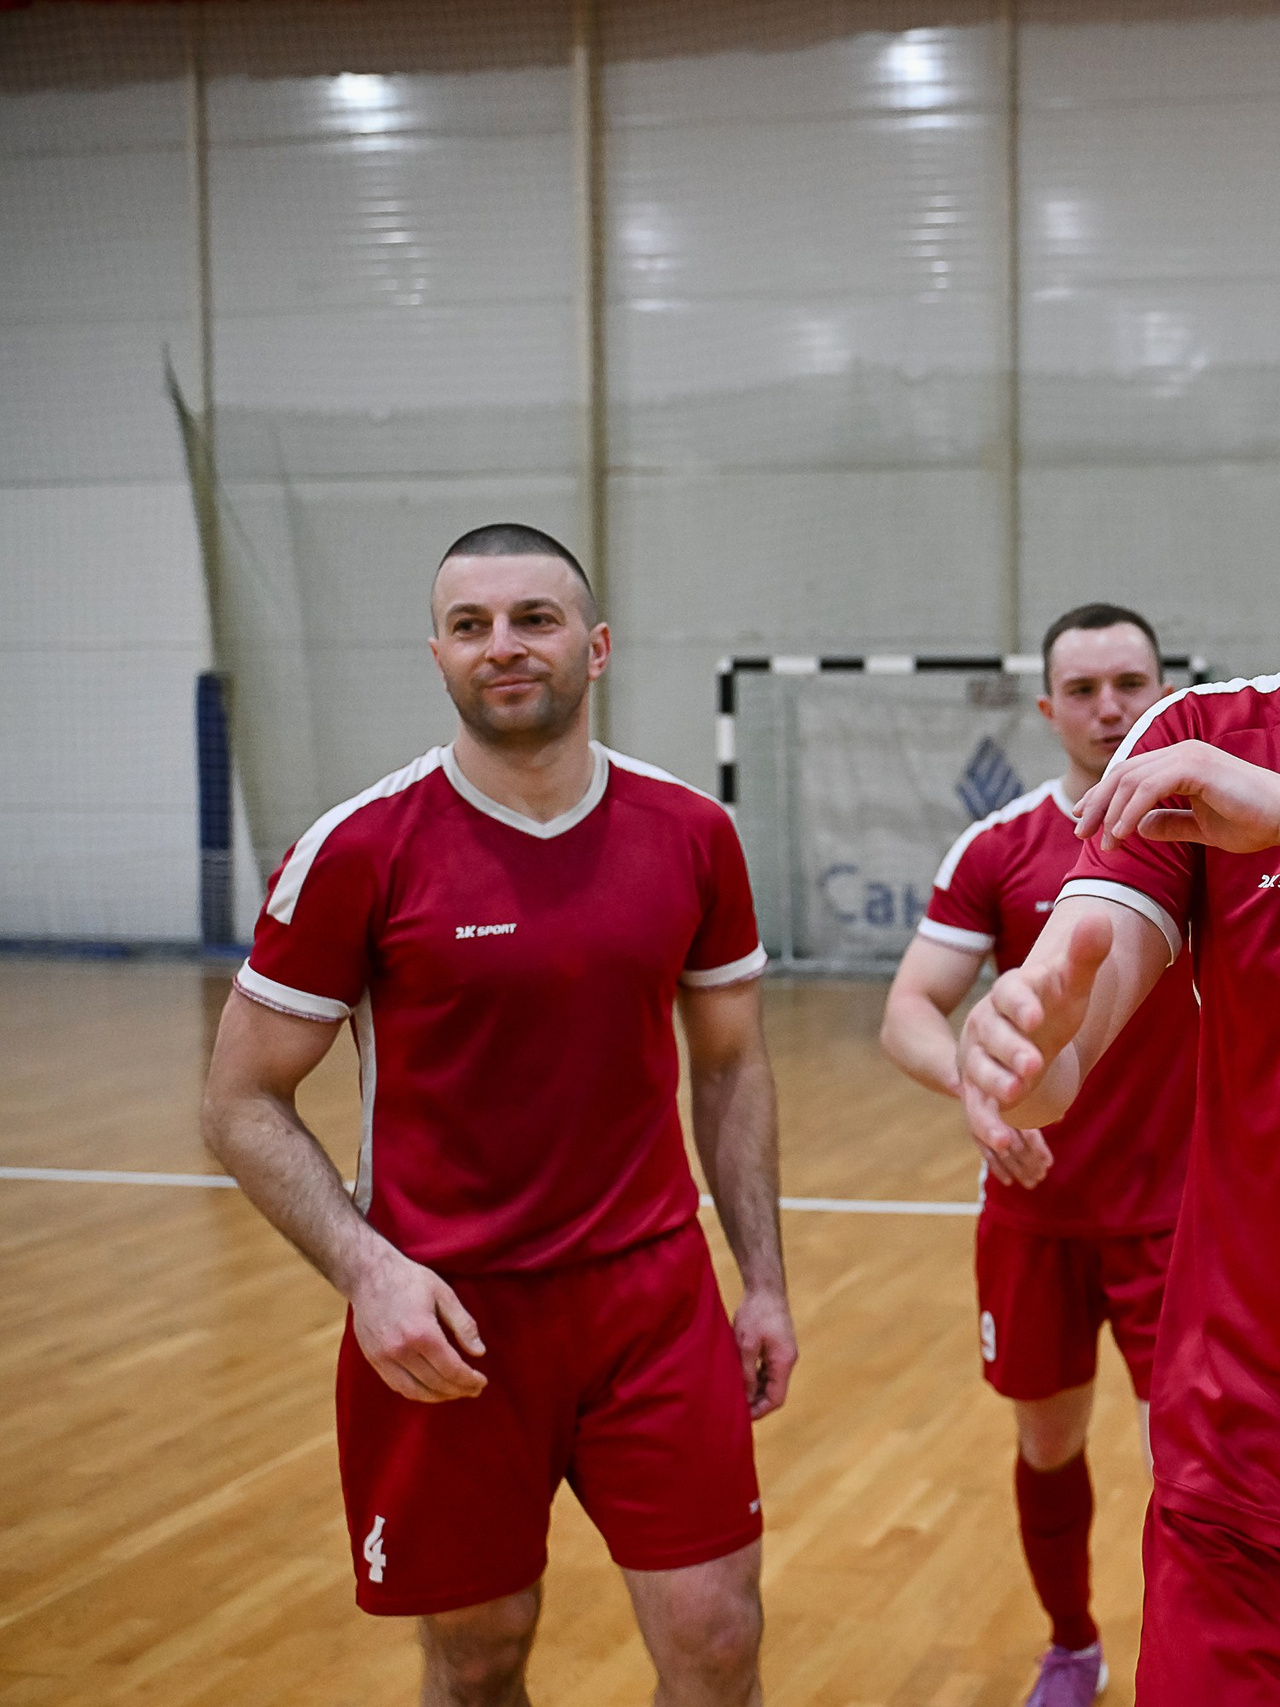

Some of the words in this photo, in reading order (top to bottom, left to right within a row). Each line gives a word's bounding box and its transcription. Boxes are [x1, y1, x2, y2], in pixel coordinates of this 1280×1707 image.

[455, 924, 477, 940] 2K
[476, 922, 518, 937] SPORT
[363, 1514, 387, 1584] 4
